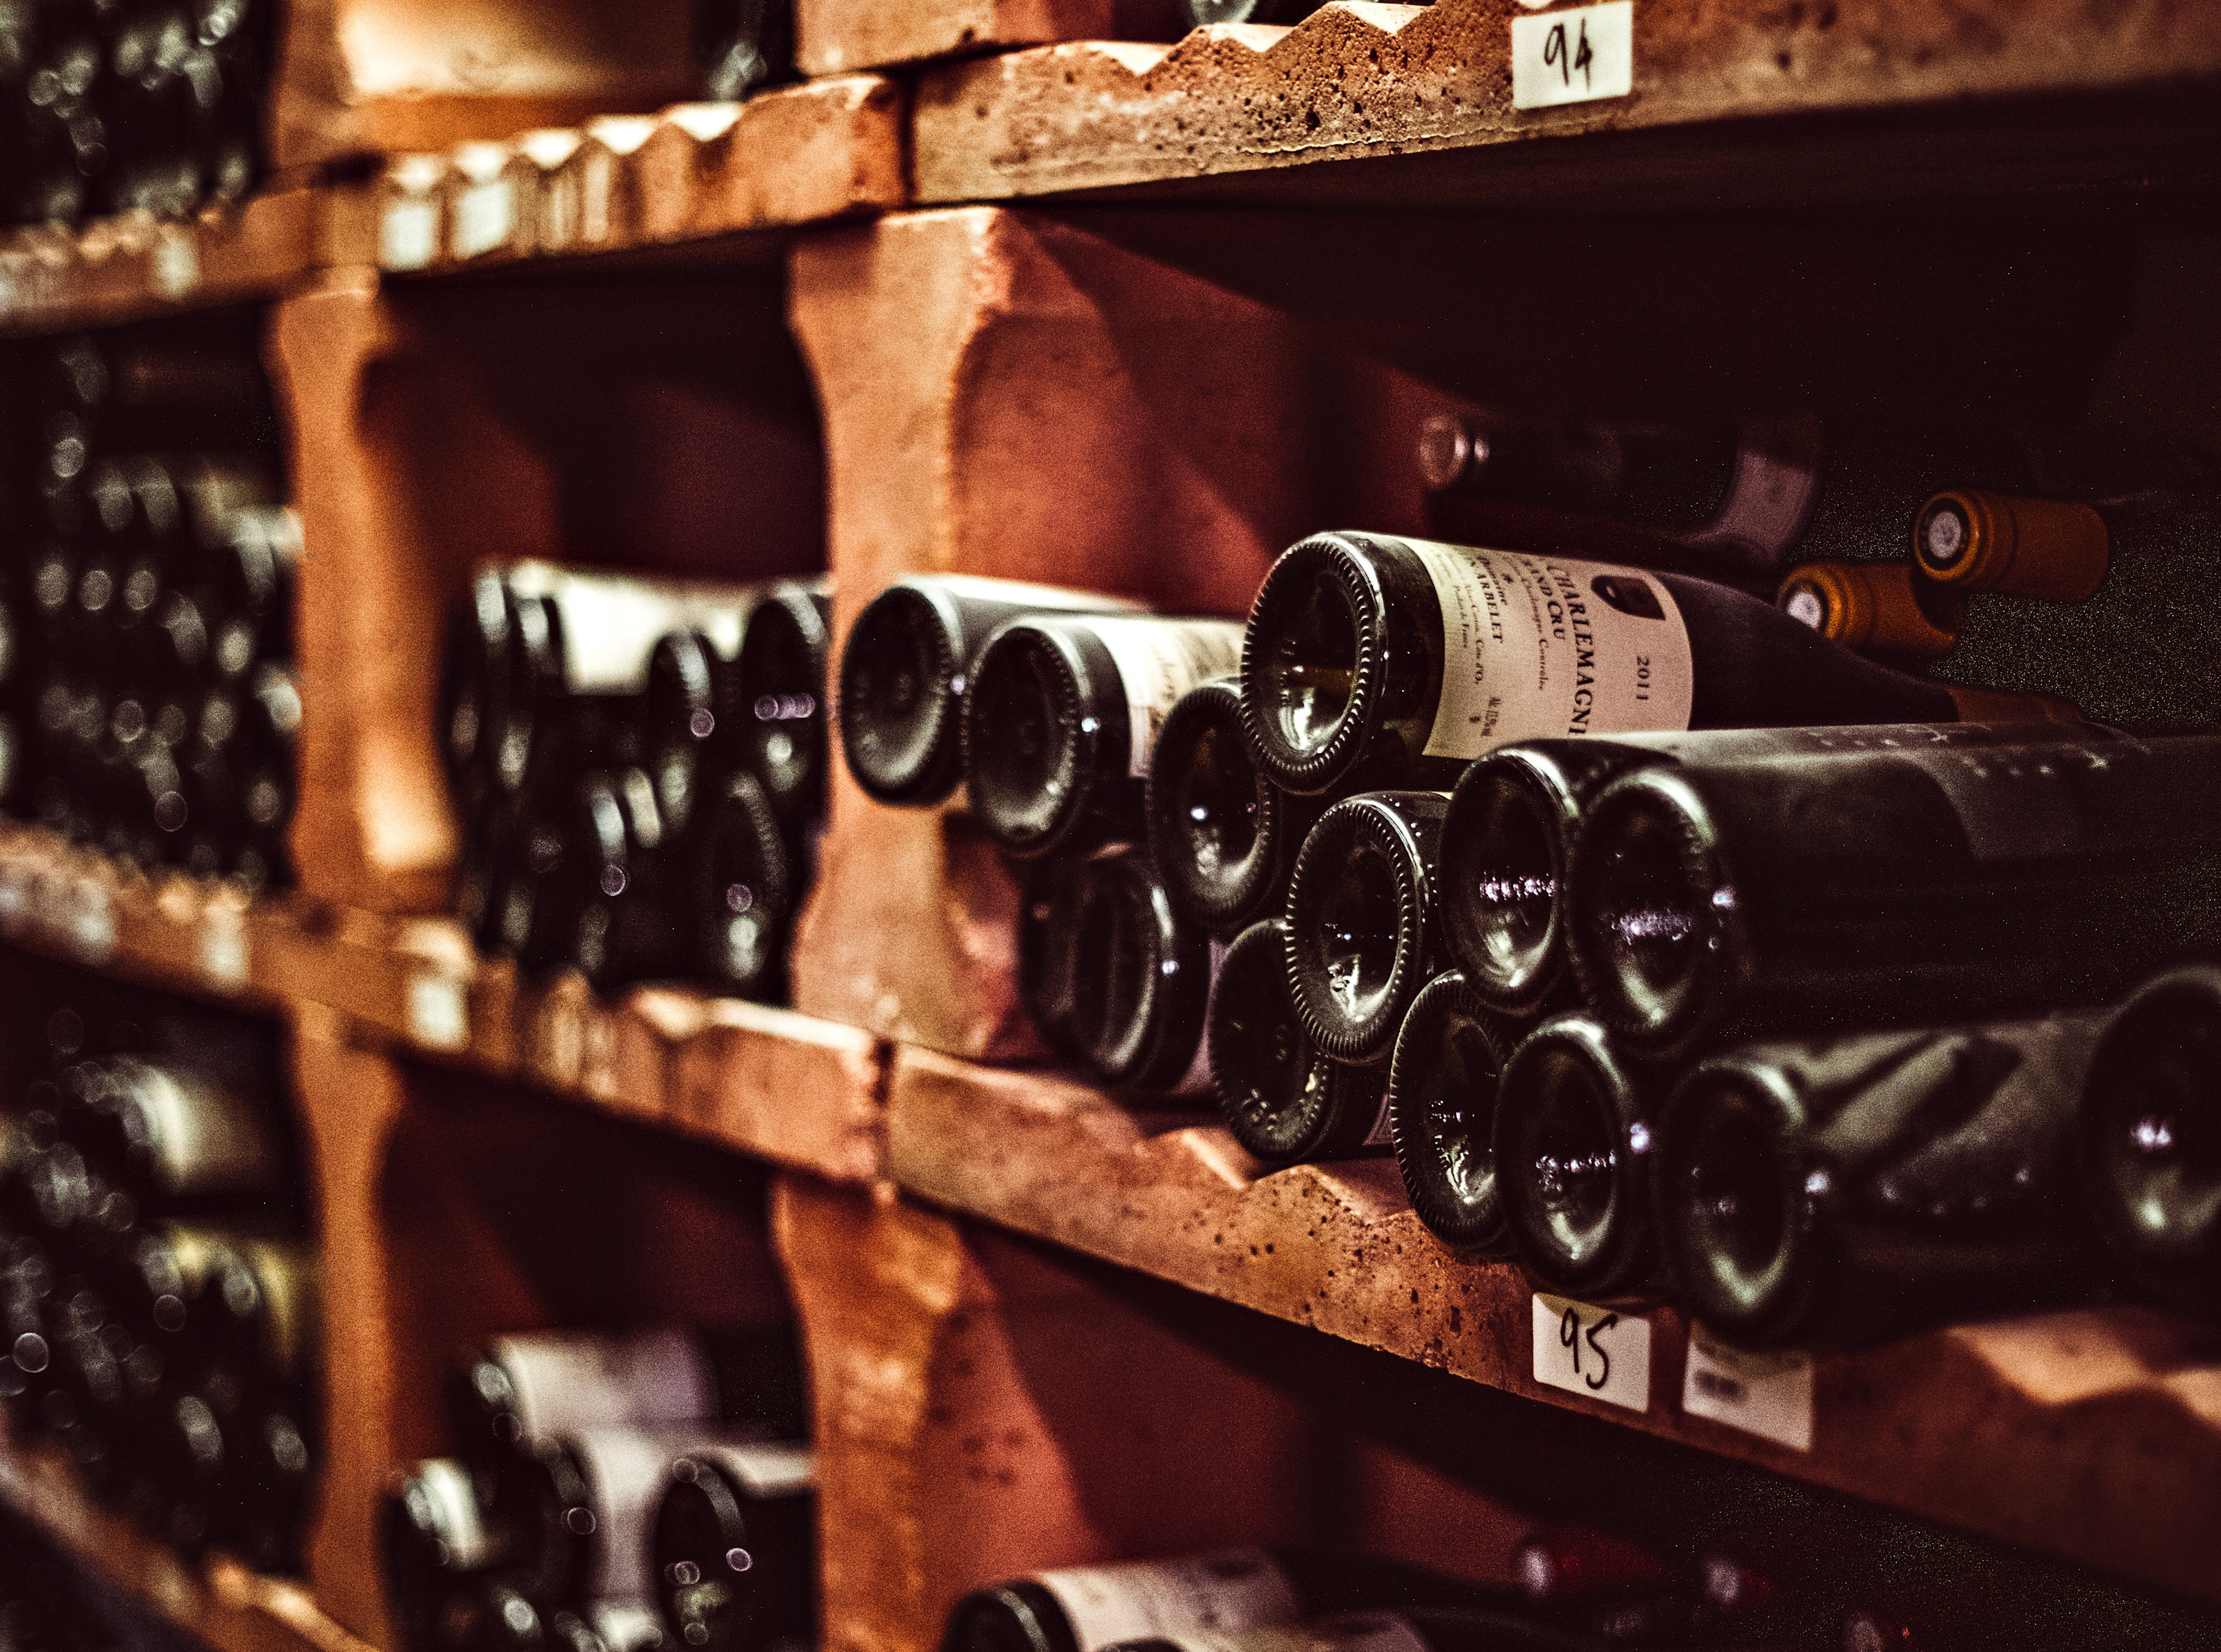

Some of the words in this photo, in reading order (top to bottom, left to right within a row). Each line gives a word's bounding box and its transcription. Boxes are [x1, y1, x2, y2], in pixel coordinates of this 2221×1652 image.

[1544, 18, 1593, 92] 94
[1546, 600, 1566, 640] CRU
[1635, 656, 1650, 701] 2011
[1560, 1308, 1619, 1390] 95
